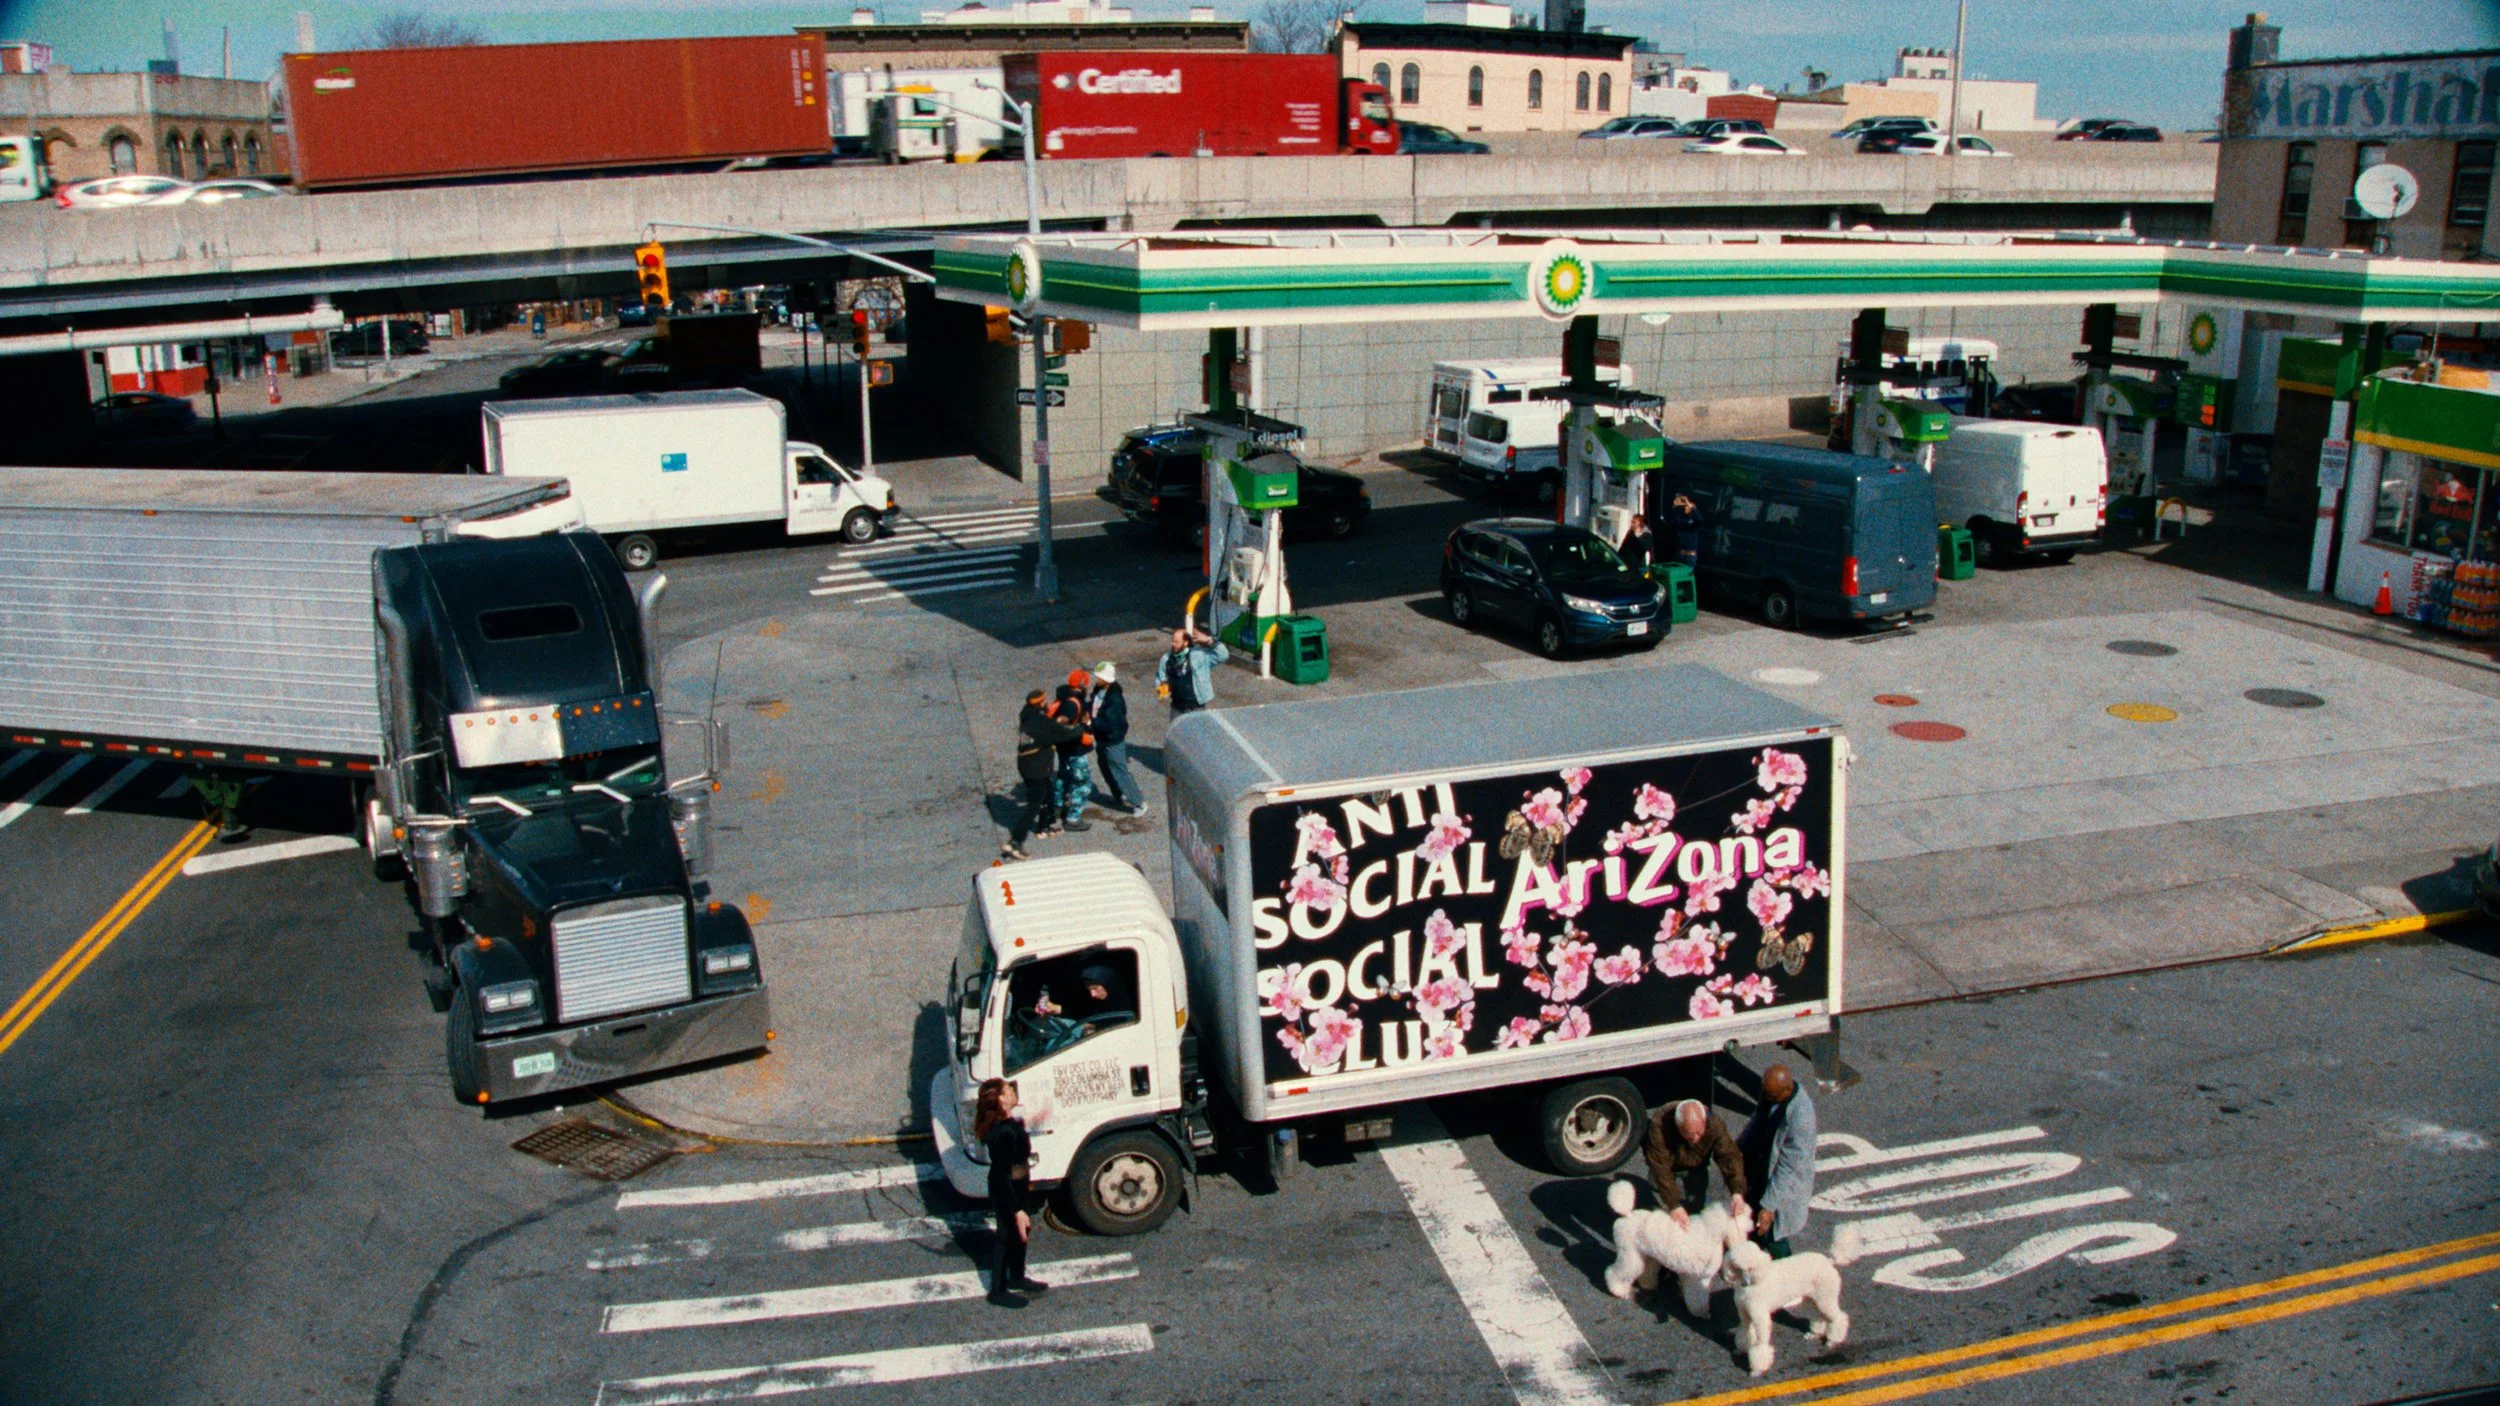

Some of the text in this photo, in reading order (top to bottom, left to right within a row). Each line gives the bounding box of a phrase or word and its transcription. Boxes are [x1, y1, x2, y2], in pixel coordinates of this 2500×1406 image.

[1078, 68, 1182, 94] Certified
[1257, 429, 1298, 441] diesel
[1252, 842, 1496, 950] SOCIAL
[1500, 827, 1806, 931] AriZona
[1256, 922, 1500, 1017] SOCIAL
[1808, 1125, 2178, 1292] STOP
